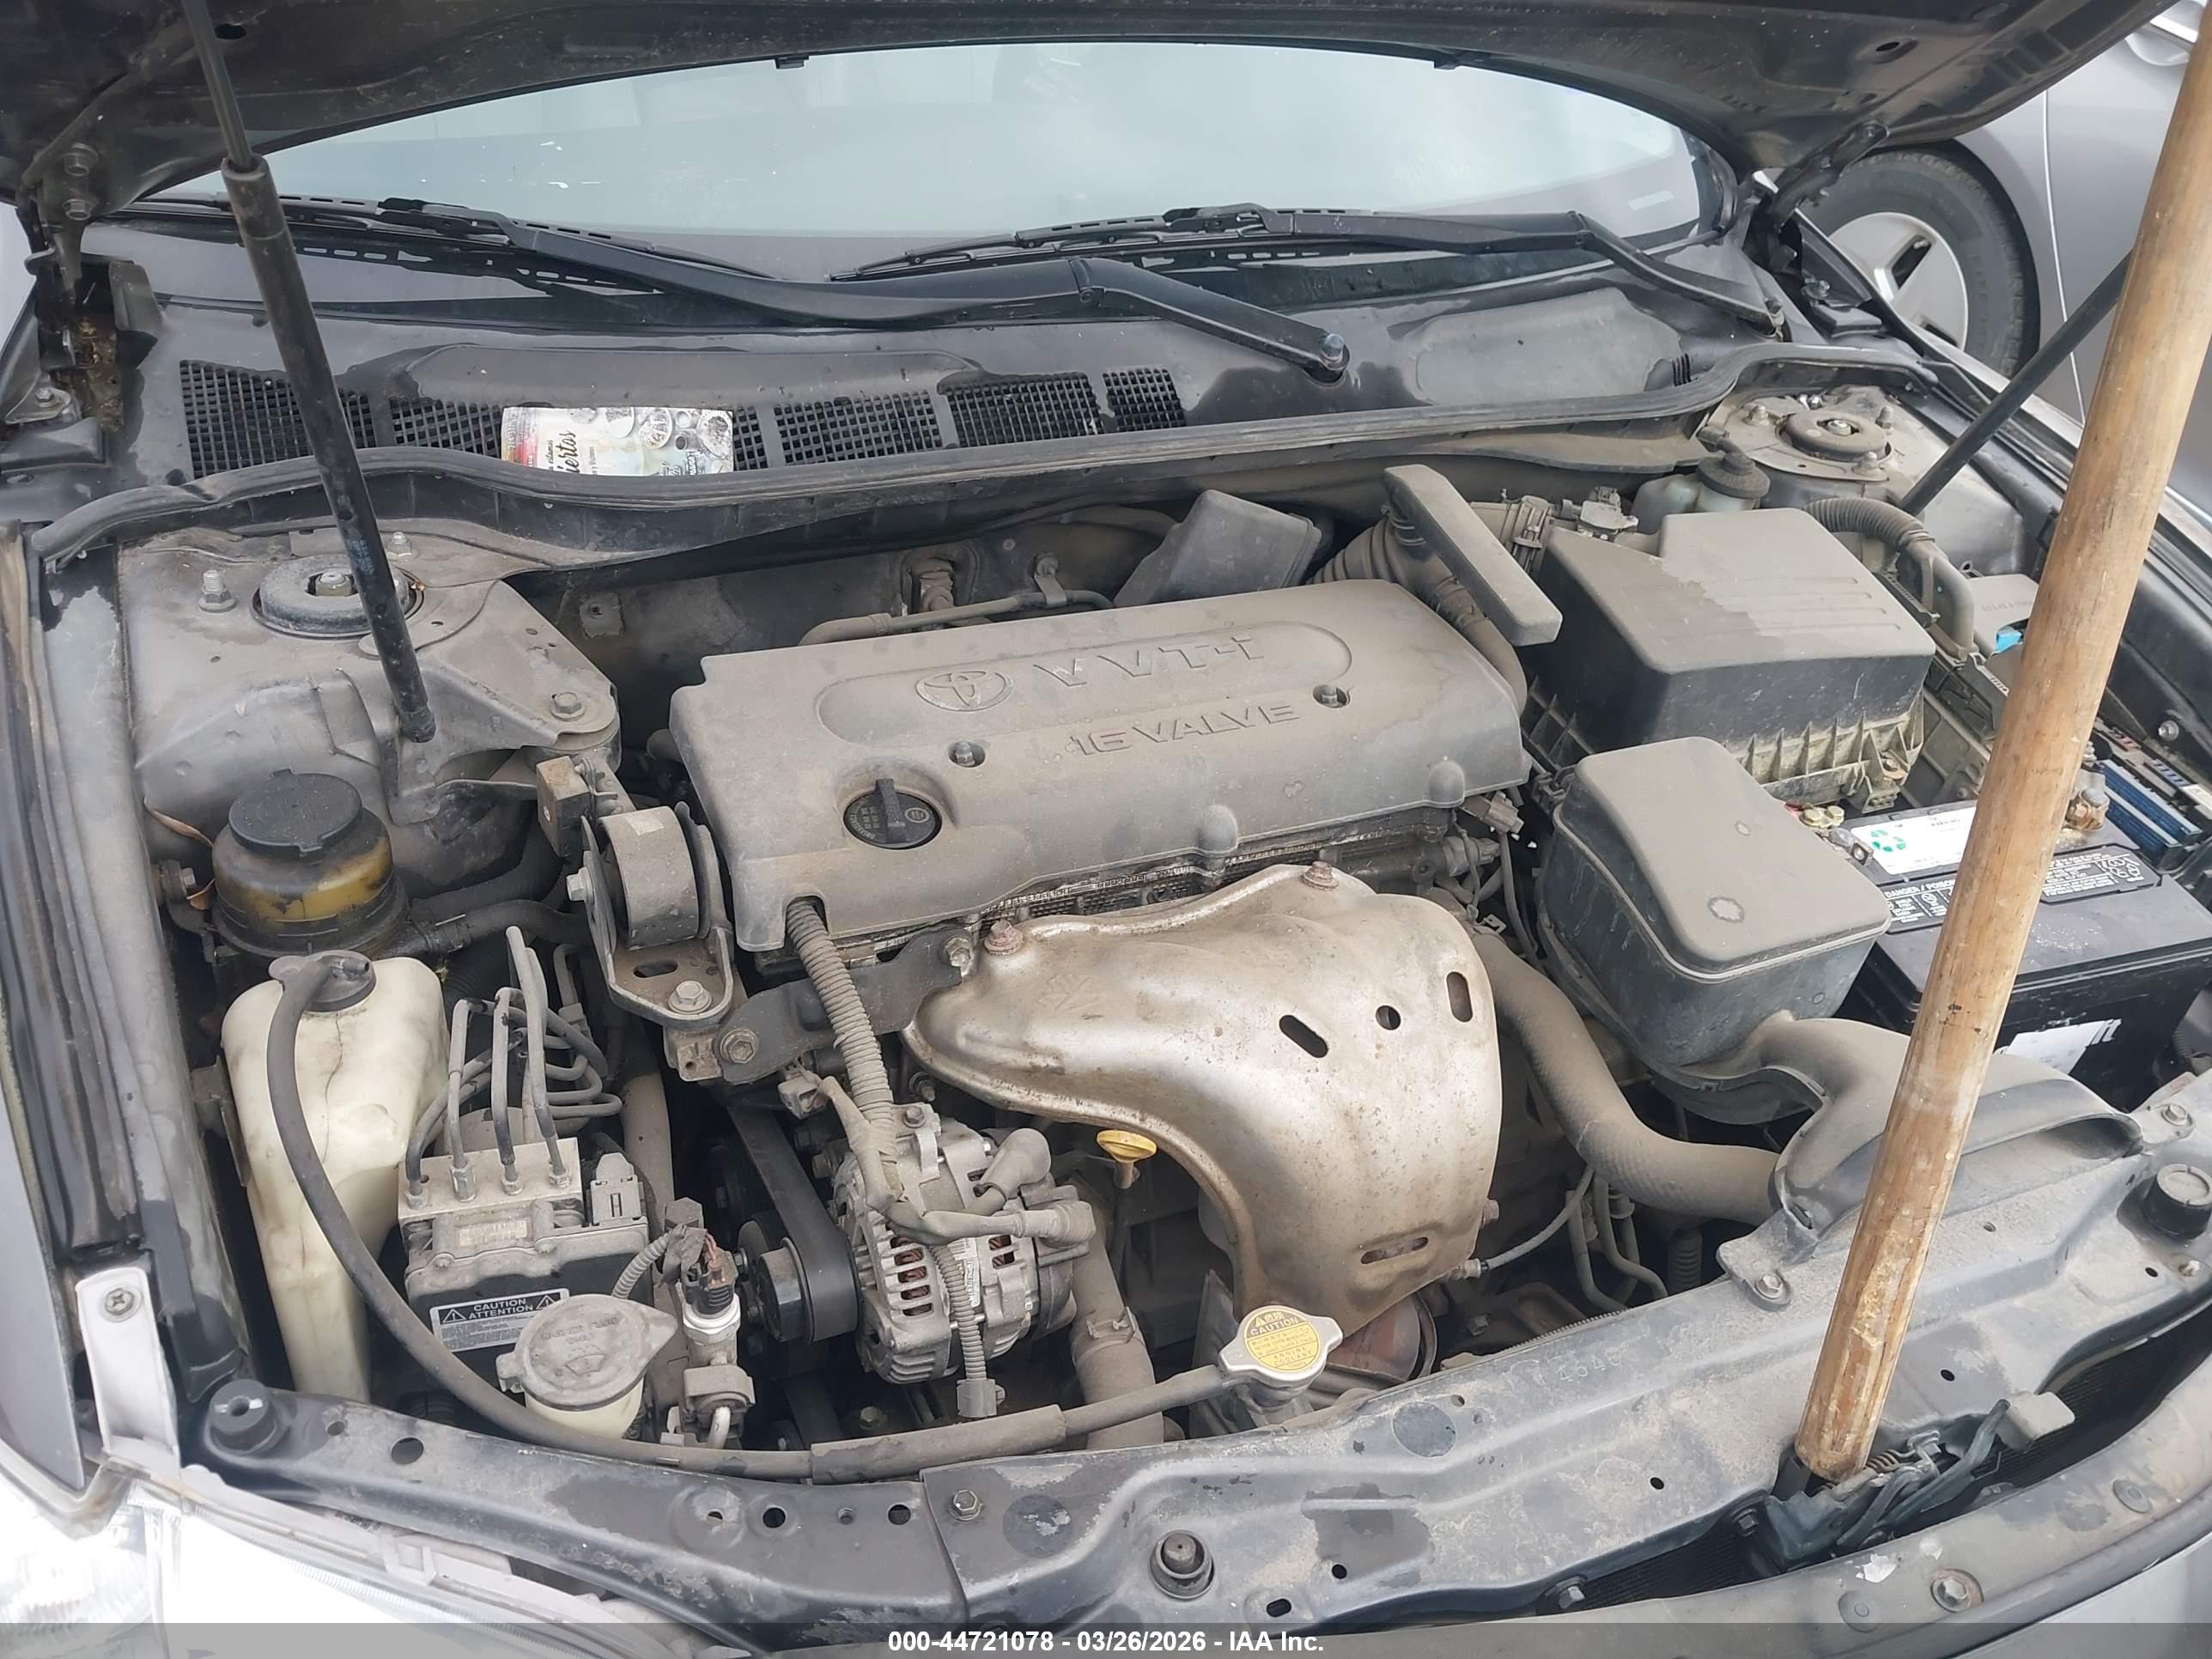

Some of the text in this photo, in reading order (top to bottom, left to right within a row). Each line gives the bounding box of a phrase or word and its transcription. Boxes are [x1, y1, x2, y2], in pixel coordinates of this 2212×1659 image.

[555, 431, 580, 474] iertos
[1883, 886, 1919, 898] DANGER
[468, 1304, 533, 1320] ATTENTION
[473, 1297, 526, 1312] CAUTION
[1249, 1316, 1300, 1337] CAUTION
